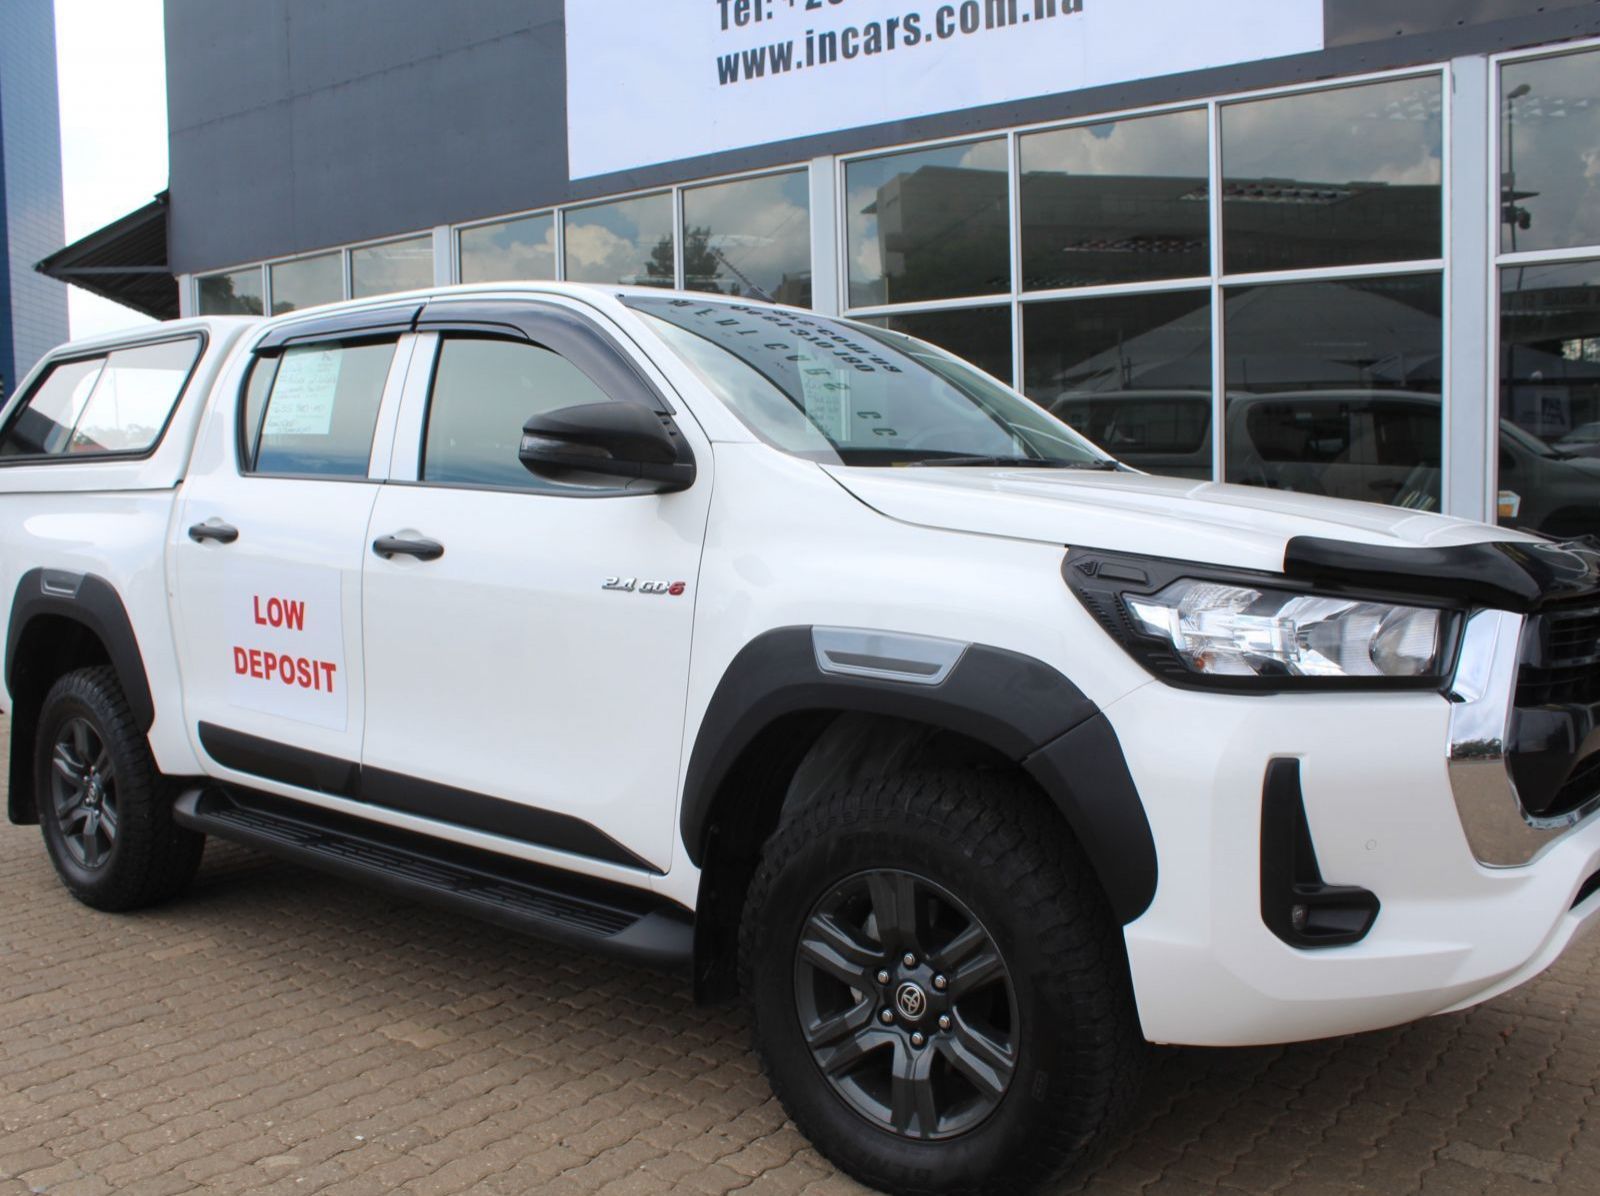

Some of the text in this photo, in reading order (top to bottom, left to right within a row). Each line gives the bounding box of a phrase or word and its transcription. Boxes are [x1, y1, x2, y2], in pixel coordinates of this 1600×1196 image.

[639, 579, 686, 597] GD6
[253, 595, 305, 631] LOW
[233, 646, 337, 693] DEPOSIT
